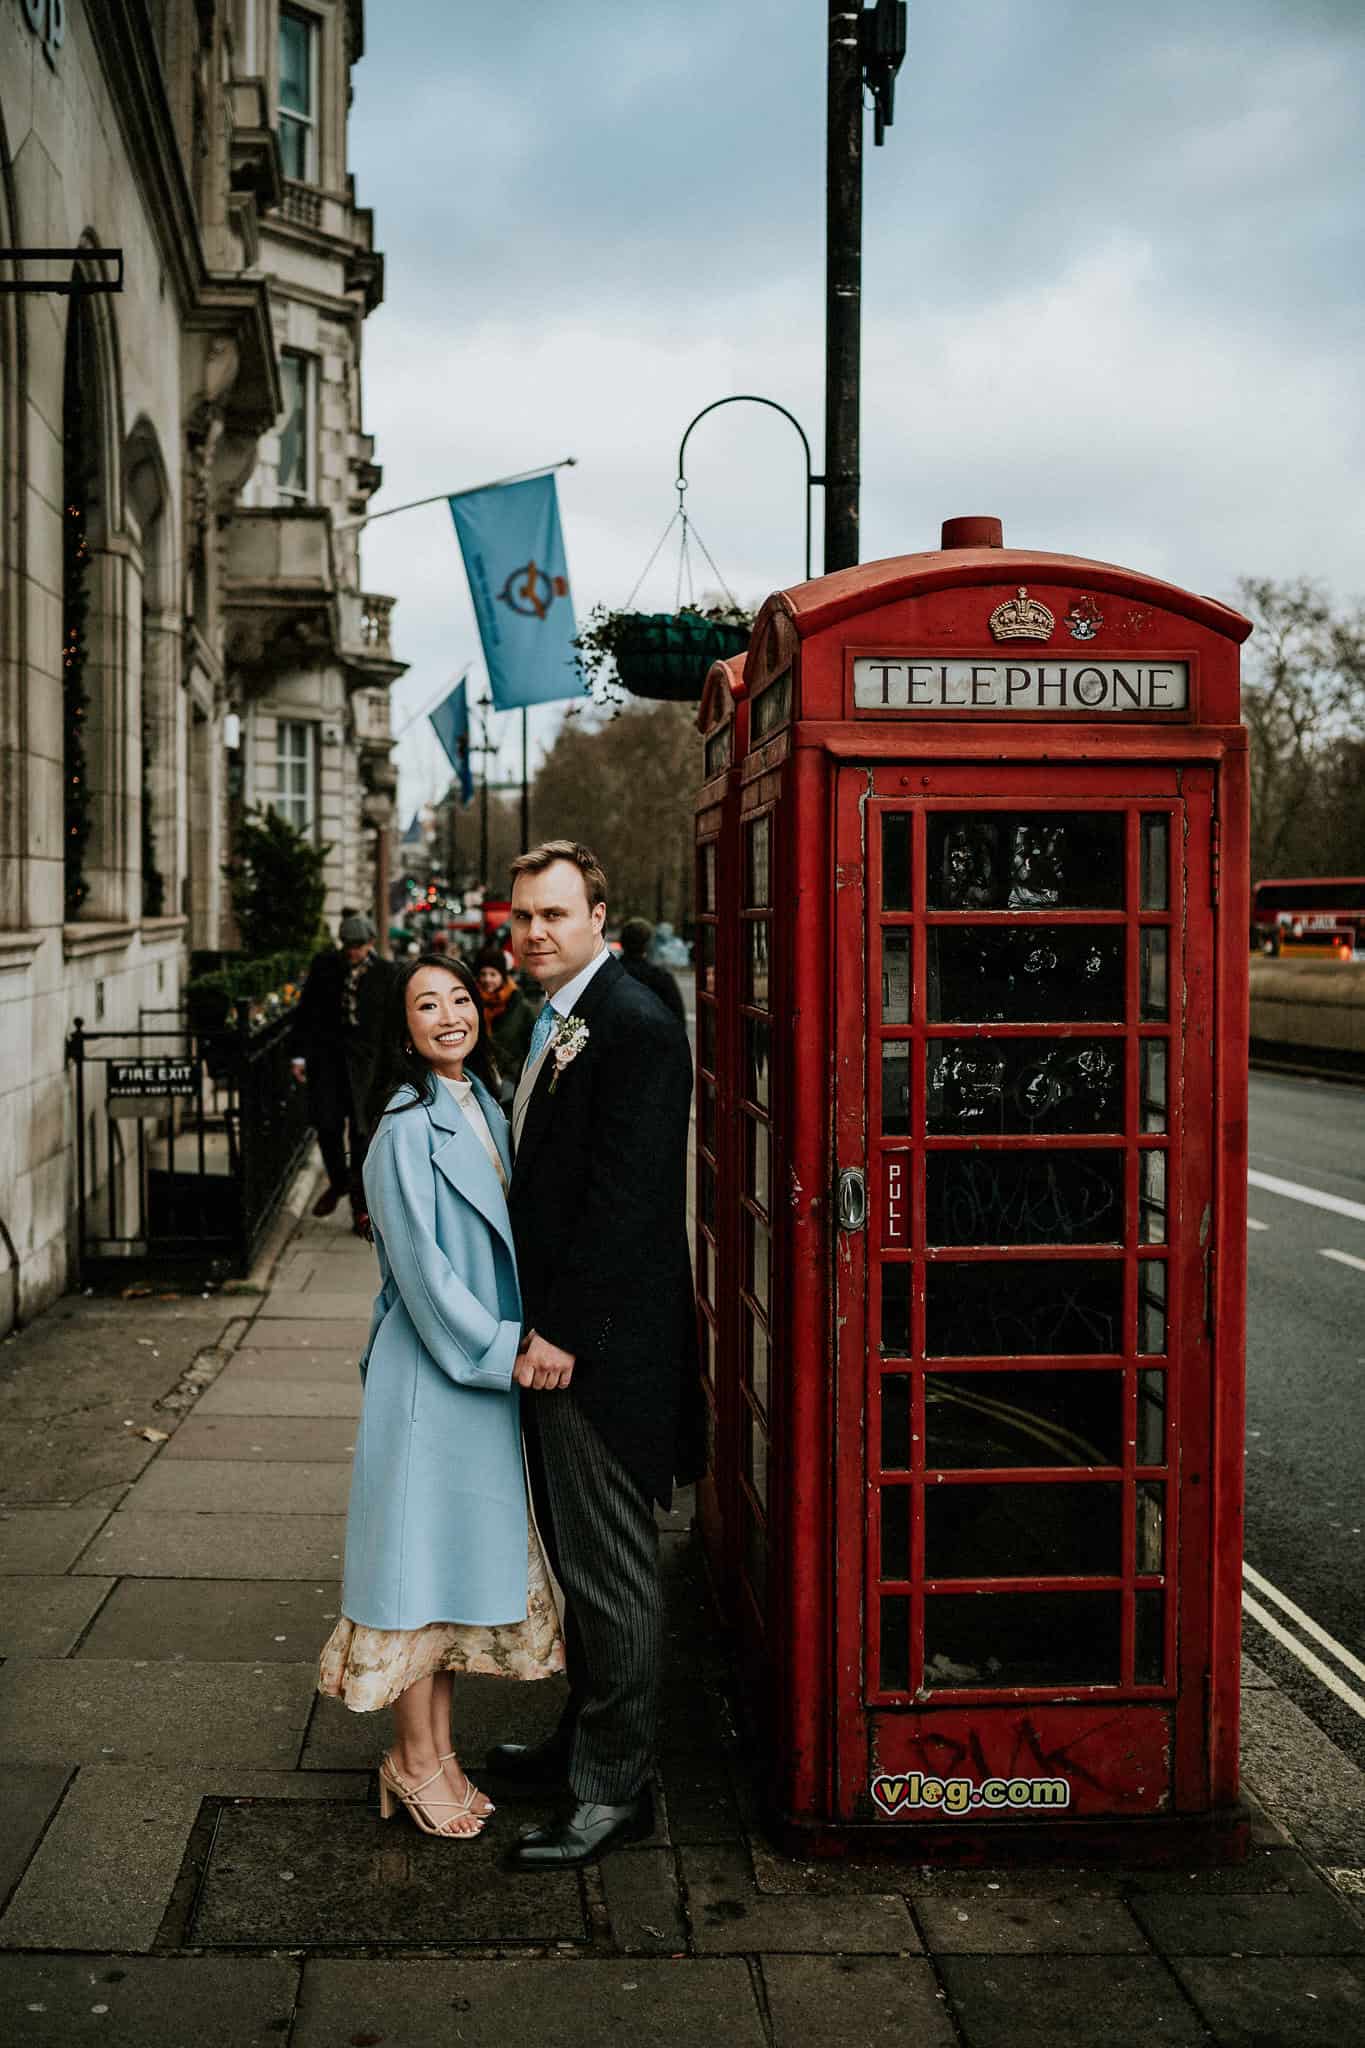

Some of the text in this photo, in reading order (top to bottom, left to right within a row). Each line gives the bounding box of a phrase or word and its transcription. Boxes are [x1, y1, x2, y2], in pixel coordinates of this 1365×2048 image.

[869, 665, 1175, 709] TELEPHONE
[118, 1066, 192, 1081] FIRE EXIT
[888, 1164, 902, 1237] PULL
